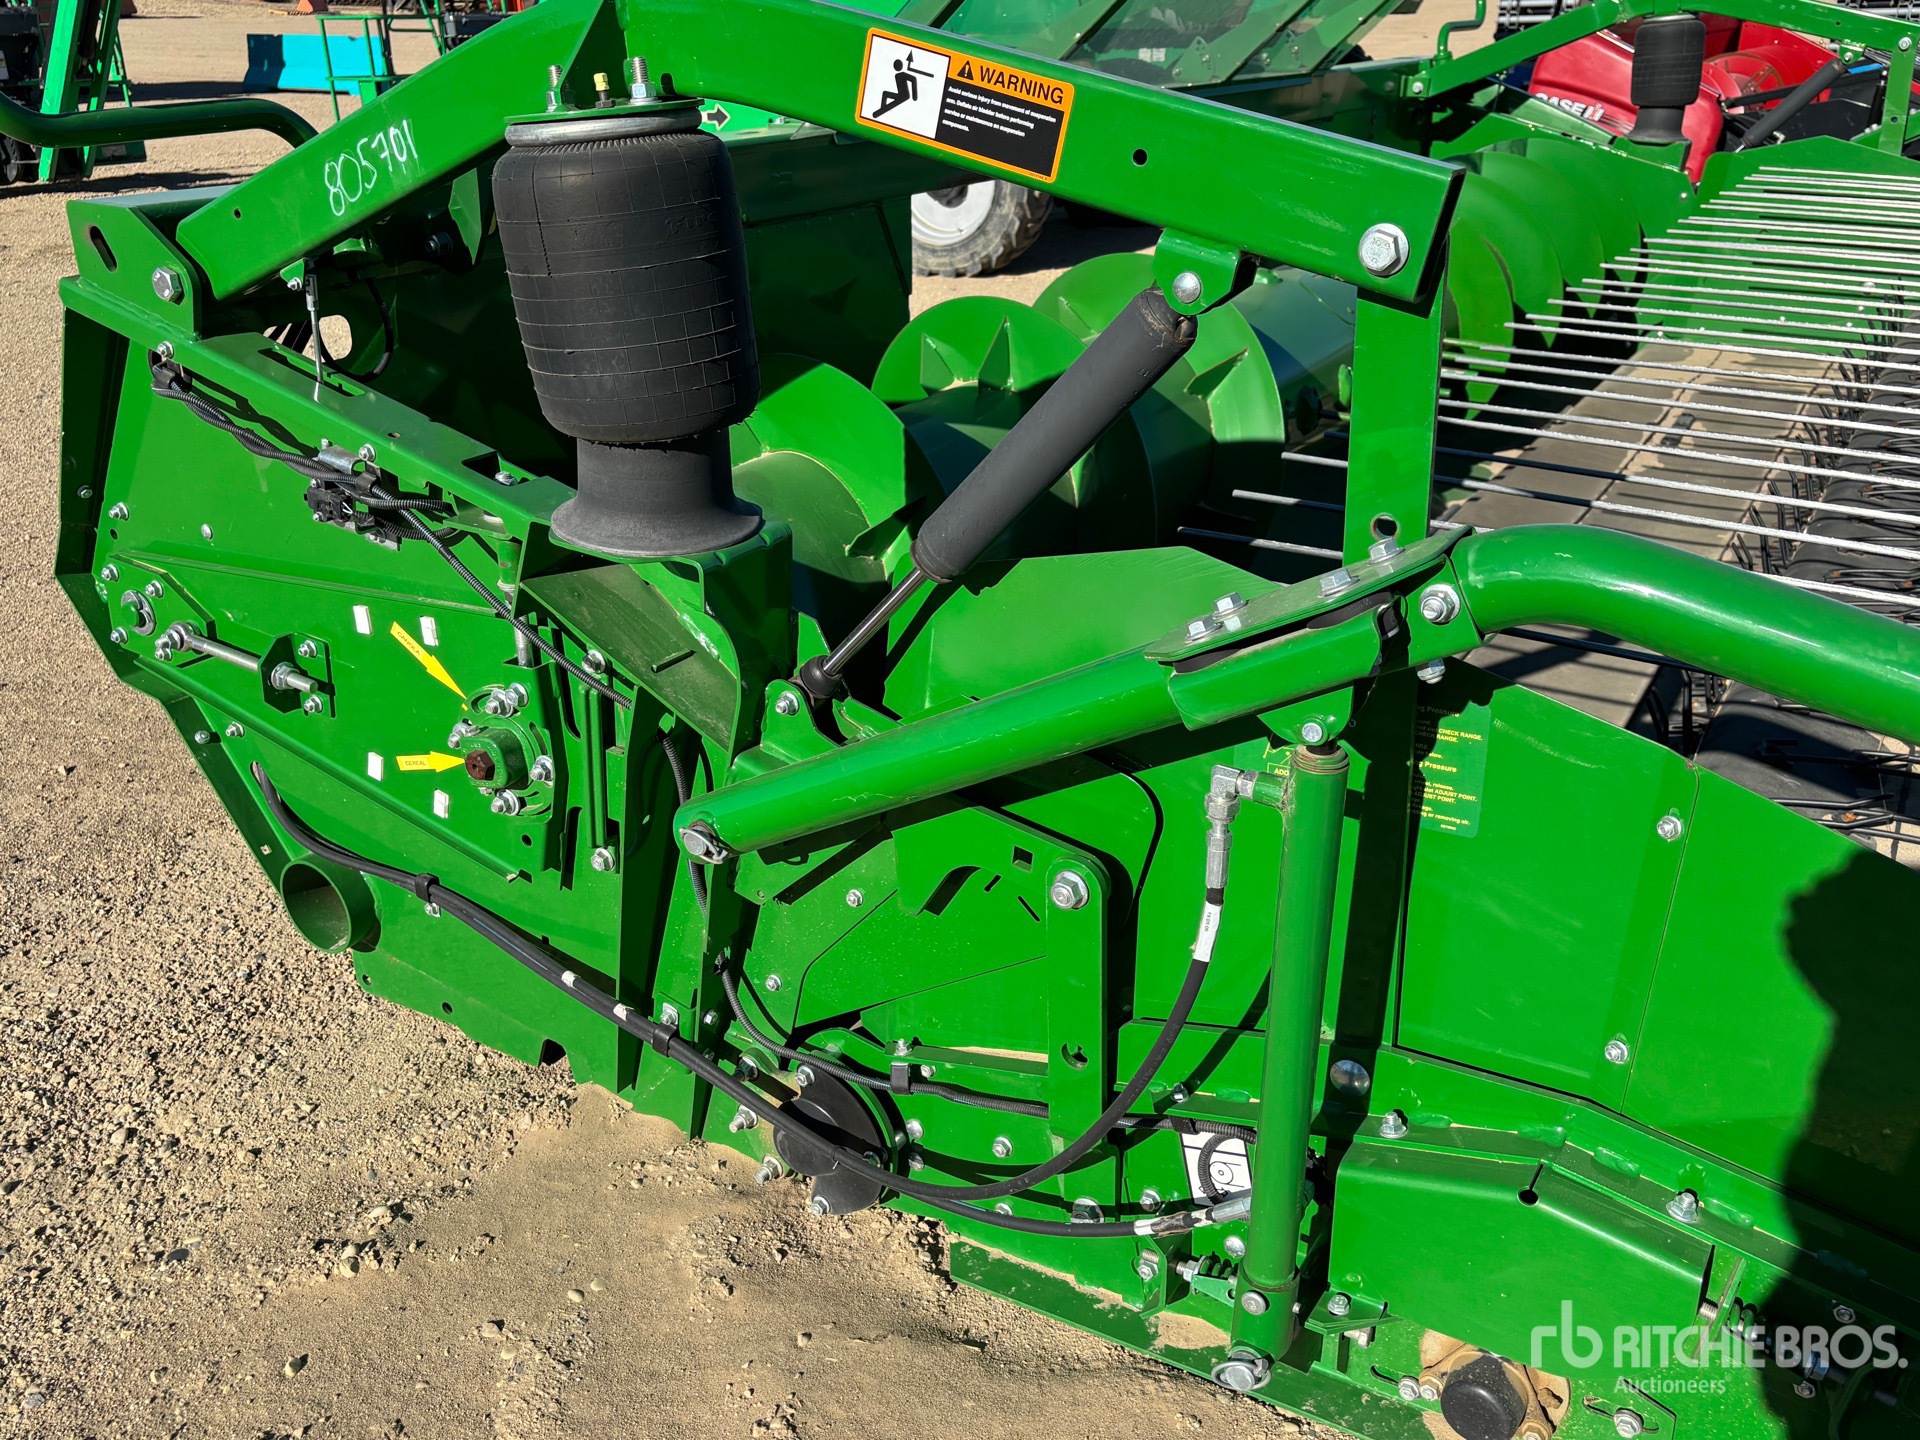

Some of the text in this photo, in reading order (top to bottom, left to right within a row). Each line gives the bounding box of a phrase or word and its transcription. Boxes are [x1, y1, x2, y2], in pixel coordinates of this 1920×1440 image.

[980, 65, 1065, 105] WARNING
[961, 90, 977, 100] serious
[978, 94, 991, 105] injury
[991, 98, 1002, 107] from
[1001, 102, 1025, 113] movement
[1030, 111, 1057, 123] suspension
[956, 99, 972, 110] Deflate
[978, 106, 995, 117] bladder
[995, 111, 1010, 121] before
[1009, 115, 1035, 129] performing
[942, 119, 970, 132] components.
[944, 108, 960, 118] service
[965, 114, 993, 127] maintenance
[999, 124, 1026, 137] suspension
[324, 119, 418, 216] 805701
[397, 631, 421, 656] CANOLA
[1436, 734, 1459, 743] RANGE.
[1438, 728, 1459, 737] CHECK
[1460, 731, 1484, 741] RANGE.
[404, 759, 427, 767] CEREAL
[1424, 761, 1458, 773] Pressure
[1434, 789, 1458, 798] ADJUST
[1458, 793, 1478, 802] POINT.
[1437, 795, 1457, 804] POINT.
[1434, 814, 1461, 825] removing
